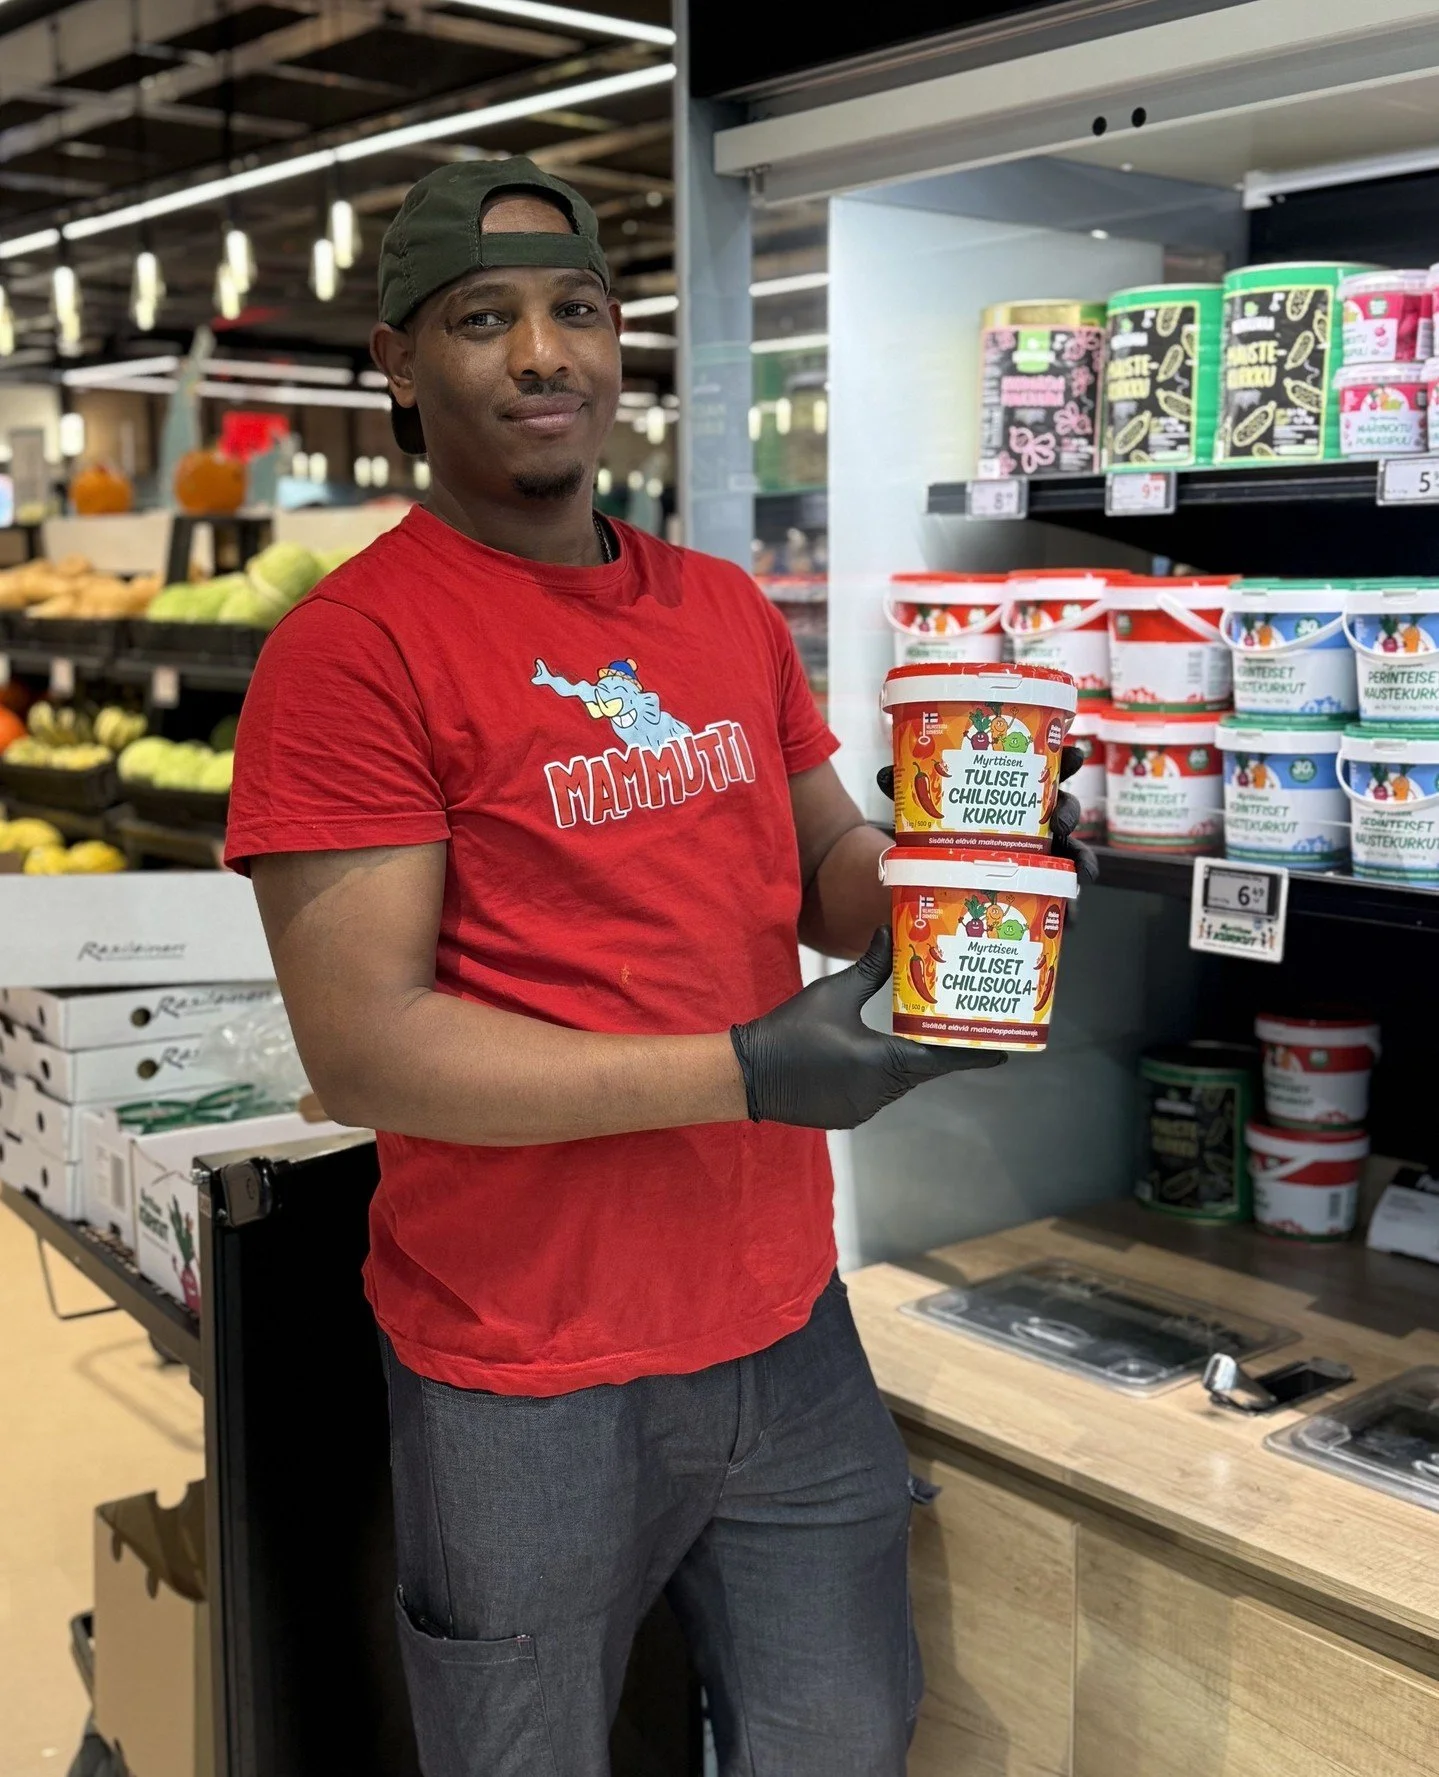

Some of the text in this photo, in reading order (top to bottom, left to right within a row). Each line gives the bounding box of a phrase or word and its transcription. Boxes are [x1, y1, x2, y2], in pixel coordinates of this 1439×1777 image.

[1419, 471, 1430, 492] 5
[973, 754, 1024, 769] Myrttisen
[544, 719, 756, 828] MAMMUTTI
[965, 769, 1028, 788] TULISET
[949, 788, 1042, 808] CHILISUOLA-
[962, 807, 1026, 826] KURKUT
[1238, 885, 1250, 906] 6
[968, 942, 1019, 957] Myrttisen
[958, 955, 1023, 976] TULISET
[942, 974, 1037, 996] CHILISUOLA-
[955, 994, 1021, 1014] KURKUT
